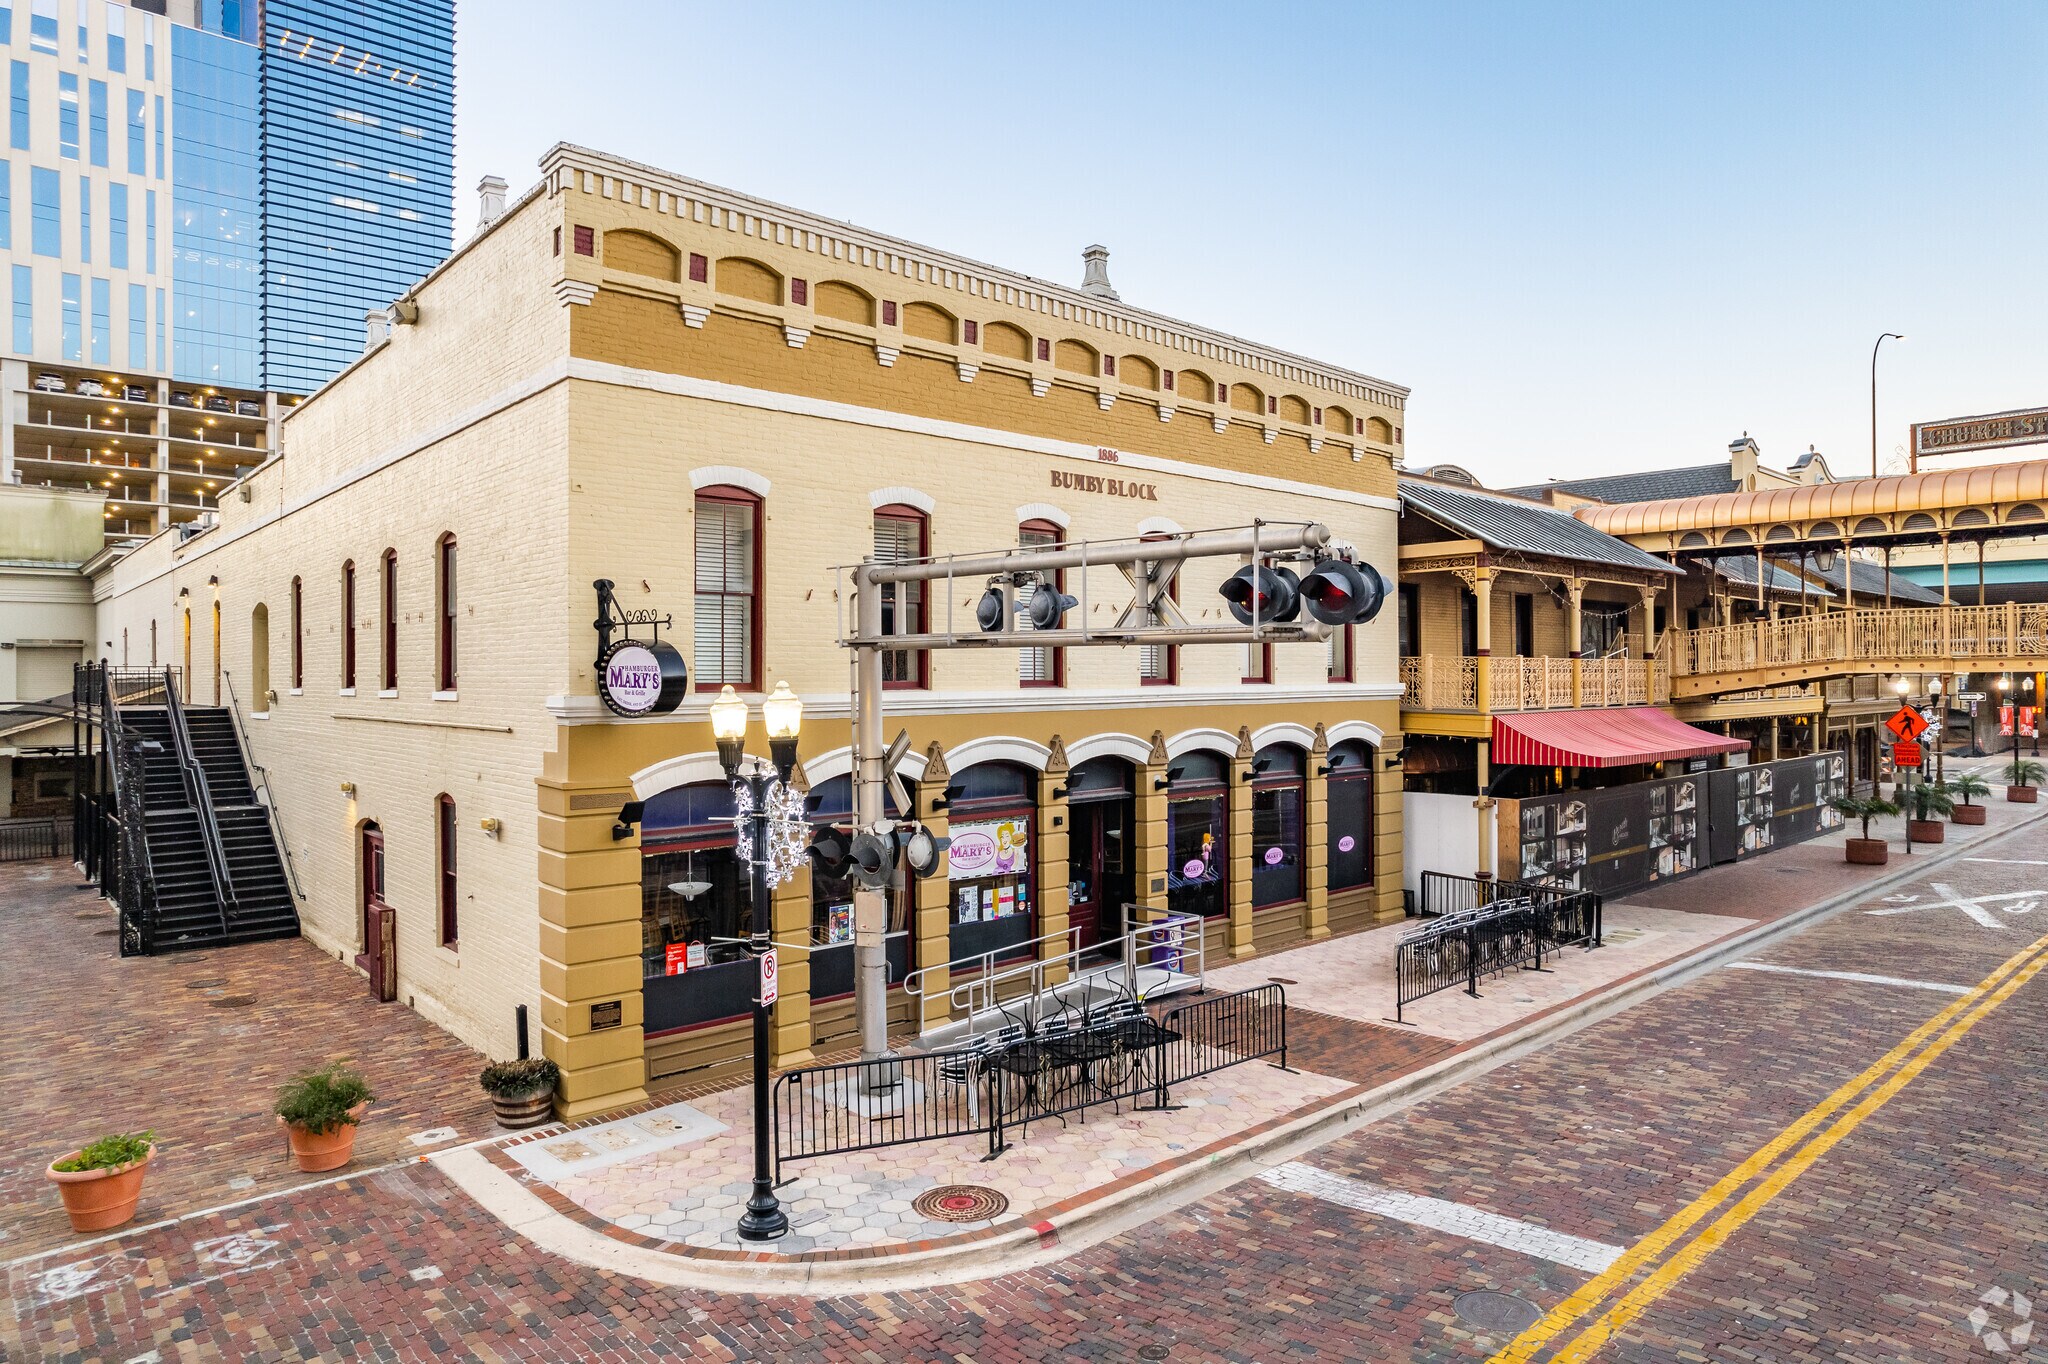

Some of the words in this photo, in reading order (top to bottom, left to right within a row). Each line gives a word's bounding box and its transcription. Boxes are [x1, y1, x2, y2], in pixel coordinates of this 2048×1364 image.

[1929, 421, 2013, 447] CHURCH
[1097, 448, 1119, 463] 1886
[1050, 470, 1105, 494] BUMBY
[1107, 479, 1158, 501] BLOCK
[609, 666, 660, 690] MARY'S
[1896, 756, 1920, 764] AHEAD
[950, 846, 992, 859] MARY'S
